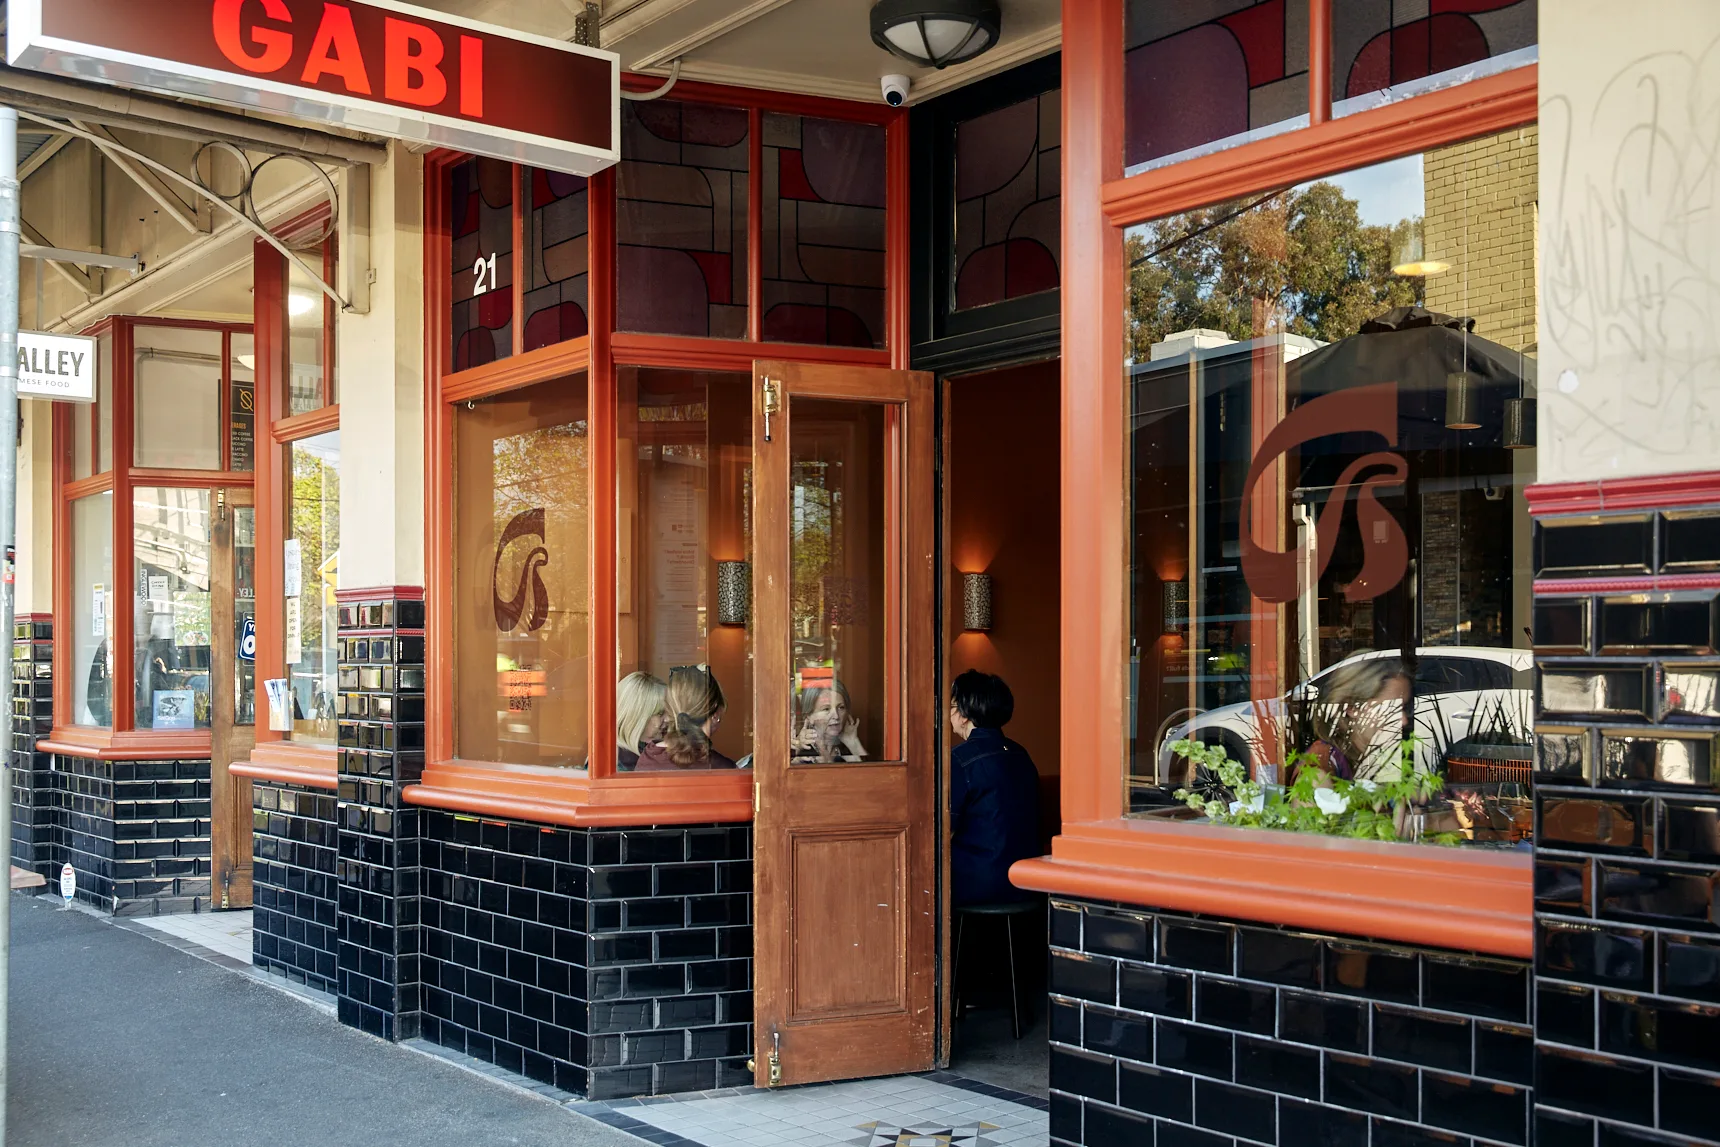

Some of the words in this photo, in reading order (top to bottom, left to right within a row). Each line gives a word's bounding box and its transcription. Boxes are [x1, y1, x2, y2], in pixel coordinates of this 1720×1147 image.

[212, 0, 483, 118] GABI
[474, 252, 496, 296] 21
[45, 380, 70, 388] FOOD
